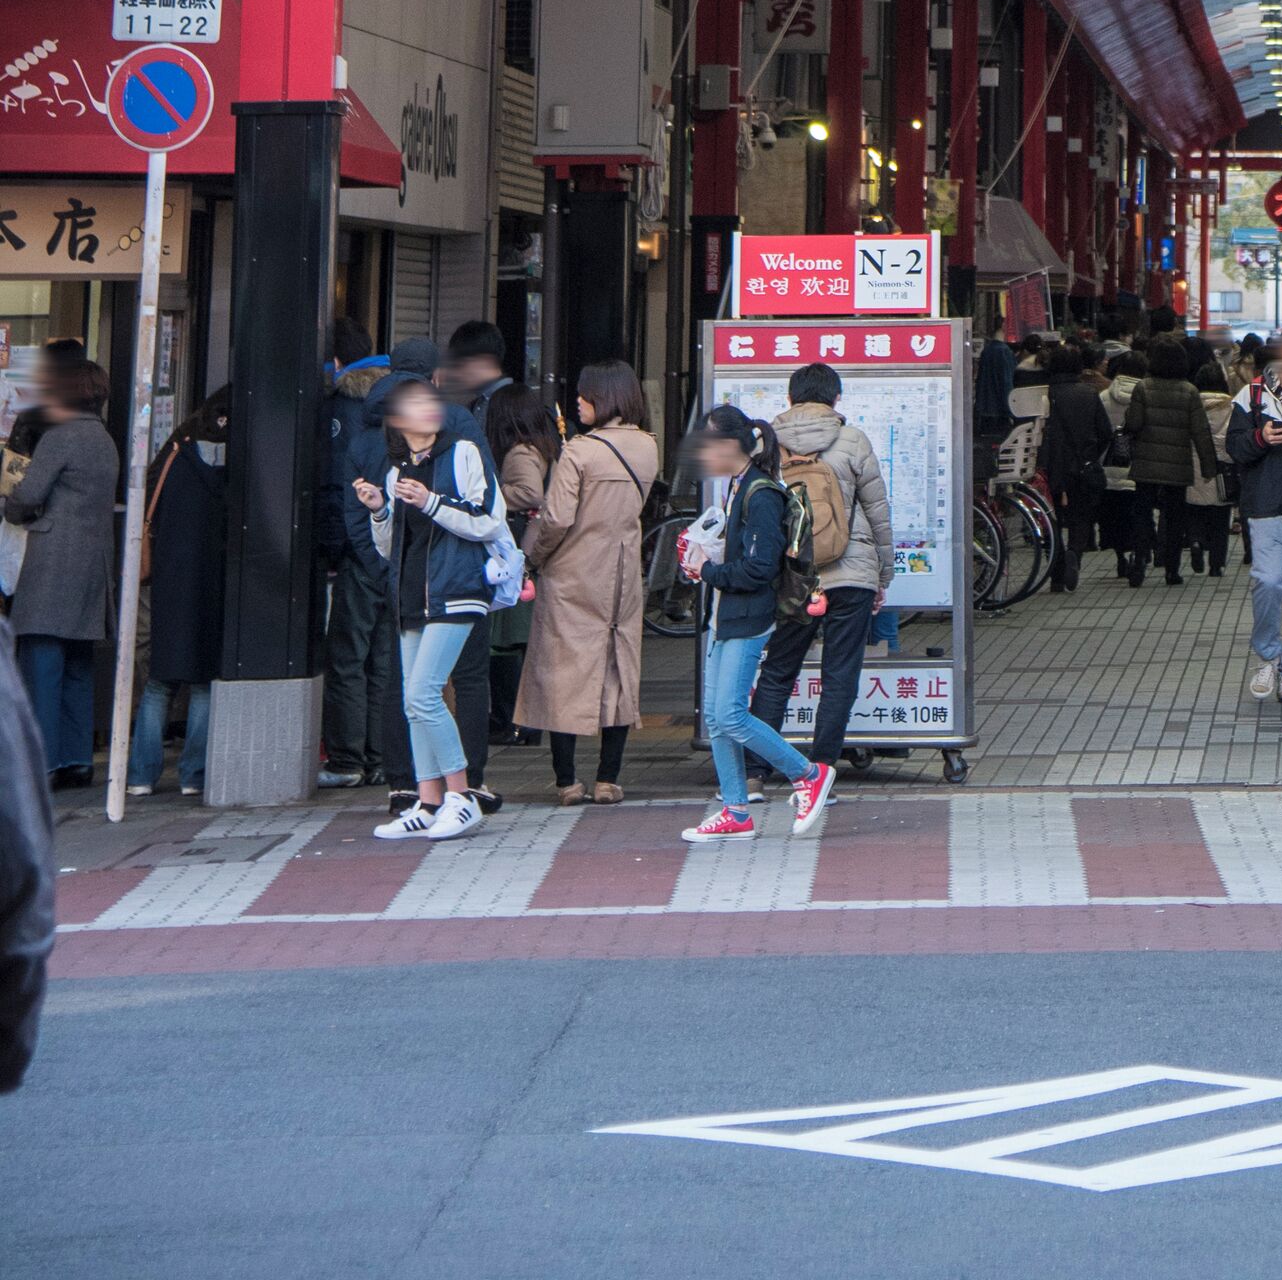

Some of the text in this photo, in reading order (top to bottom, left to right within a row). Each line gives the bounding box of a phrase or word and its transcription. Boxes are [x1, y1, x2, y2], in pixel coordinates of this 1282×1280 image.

[125, 14, 208, 37] 11-22
[0, 57, 122, 119] たらし
[760, 248, 923, 277] Welcome N-2
[746, 277, 789, 297] 환영
[800, 276, 850, 297] 欢迎
[867, 279, 916, 289] Niomon-St.
[728, 333, 937, 358] 仁王門通り
[790, 676, 949, 700] 両入禁止
[782, 705, 949, 725] 午前～午後10時
